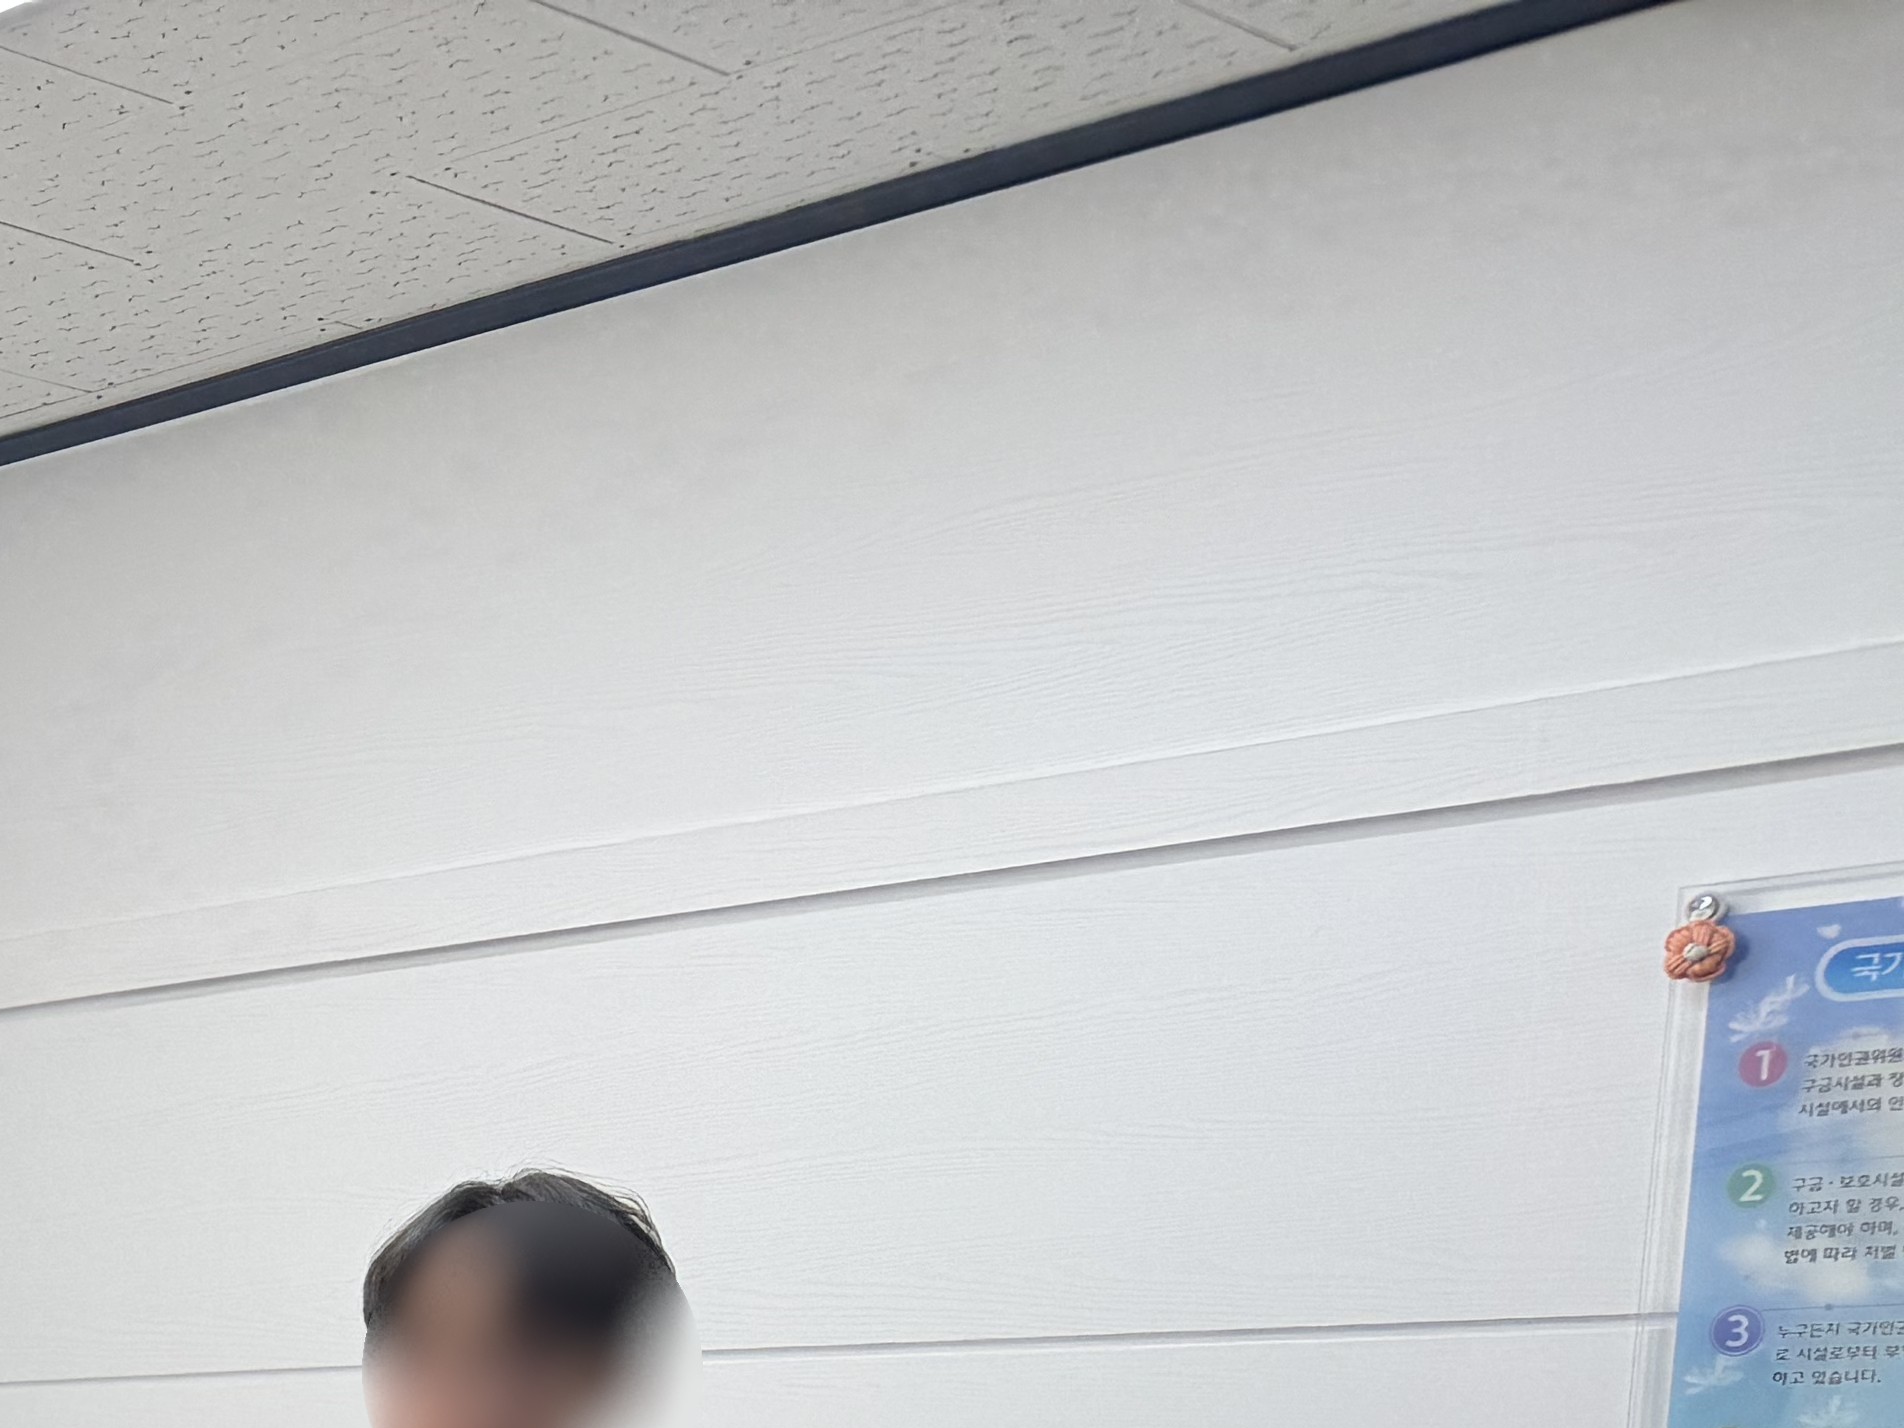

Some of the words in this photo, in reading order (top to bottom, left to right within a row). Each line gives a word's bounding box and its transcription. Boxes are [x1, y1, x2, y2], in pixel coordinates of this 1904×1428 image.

[1755, 1050, 1772, 1080] 1
[1739, 1170, 1765, 1202] 2
[1725, 1313, 1750, 1348] 3
[1778, 1322, 1840, 1339] 누구든지
[1811, 1369, 1882, 1385] 있습니다.
